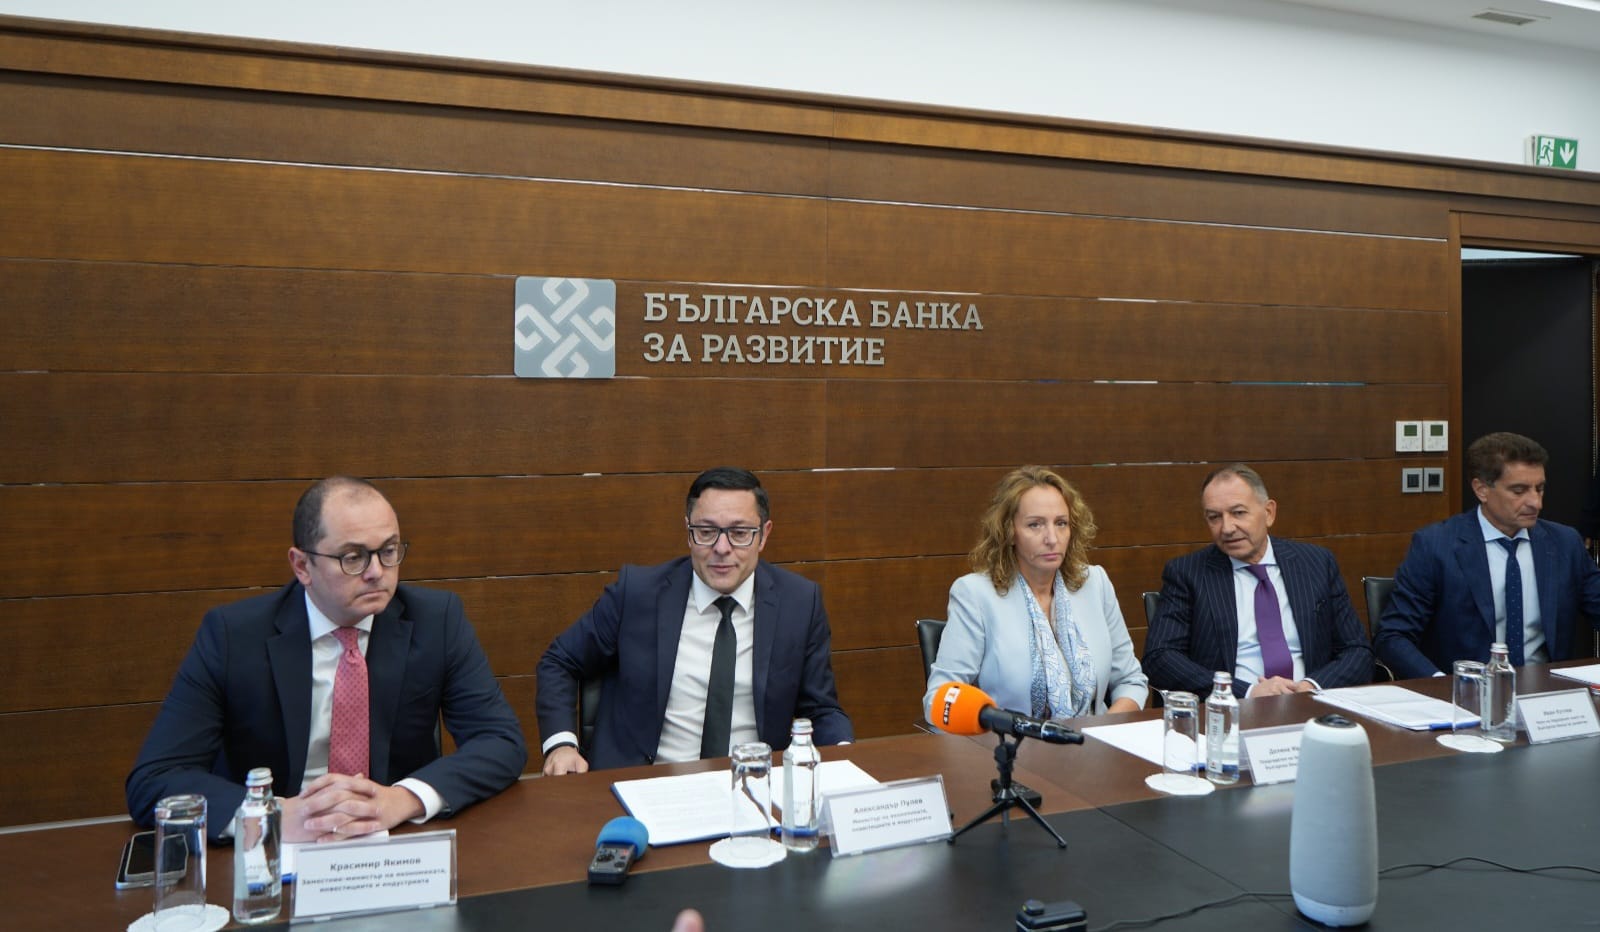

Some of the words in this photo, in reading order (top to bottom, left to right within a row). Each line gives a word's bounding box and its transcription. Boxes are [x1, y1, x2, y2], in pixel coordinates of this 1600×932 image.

[643, 292, 862, 327] БЪЛГАРСКА
[870, 300, 984, 331] БАНКА
[643, 333, 692, 363] ЗА
[701, 335, 886, 366] РАЗВИТИЕ
[330, 860, 381, 872] Красимир
[384, 857, 421, 867] Якимов
